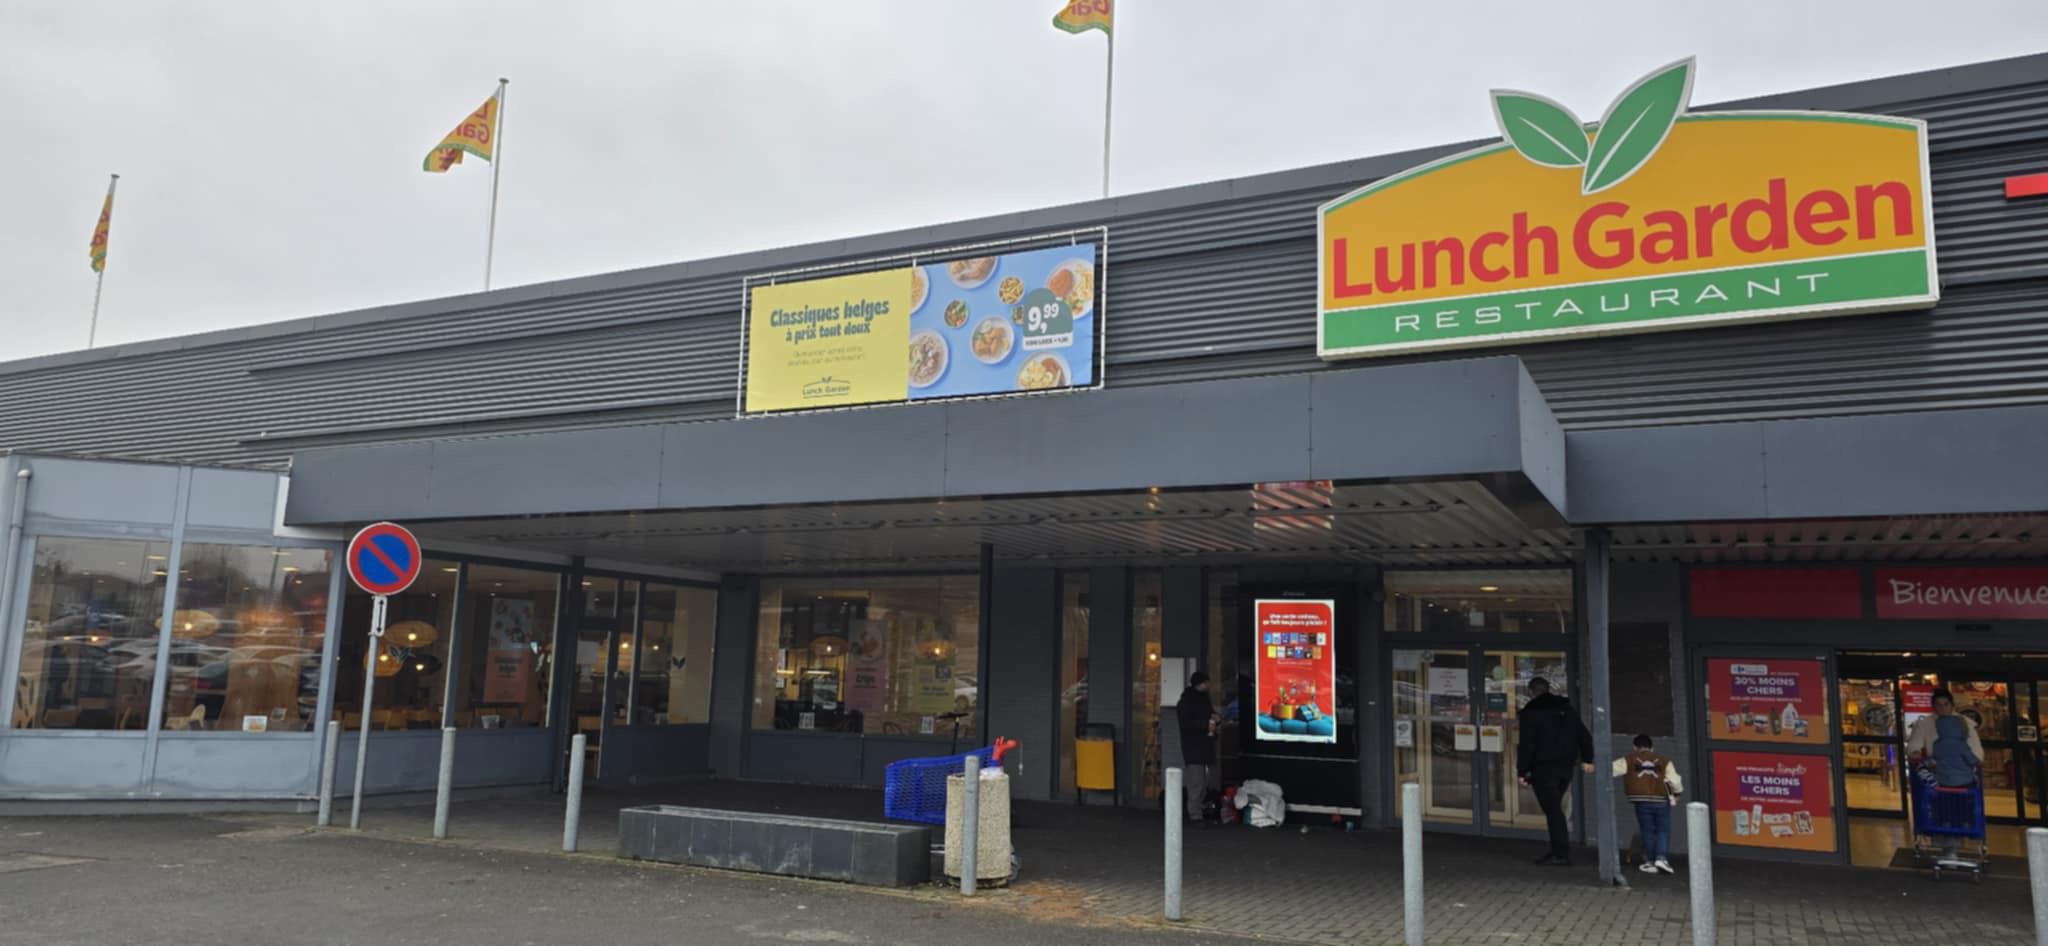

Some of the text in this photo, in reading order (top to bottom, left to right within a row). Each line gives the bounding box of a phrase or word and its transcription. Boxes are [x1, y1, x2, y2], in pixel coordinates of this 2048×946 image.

[1333, 177, 1914, 299] Lunch Garden
[770, 299, 889, 327] Classiques belges
[1394, 272, 1829, 332] RESTAURANT
[794, 325, 817, 344] prix
[819, 324, 841, 338] tout
[844, 321, 871, 335] doux
[1889, 578, 2048, 606] Bienvenue
[1746, 686, 1784, 695] CHERS
[1758, 677, 1795, 687] MOINS
[1741, 775, 1801, 787] LES MOINS
[1752, 785, 1790, 796] CHERS
